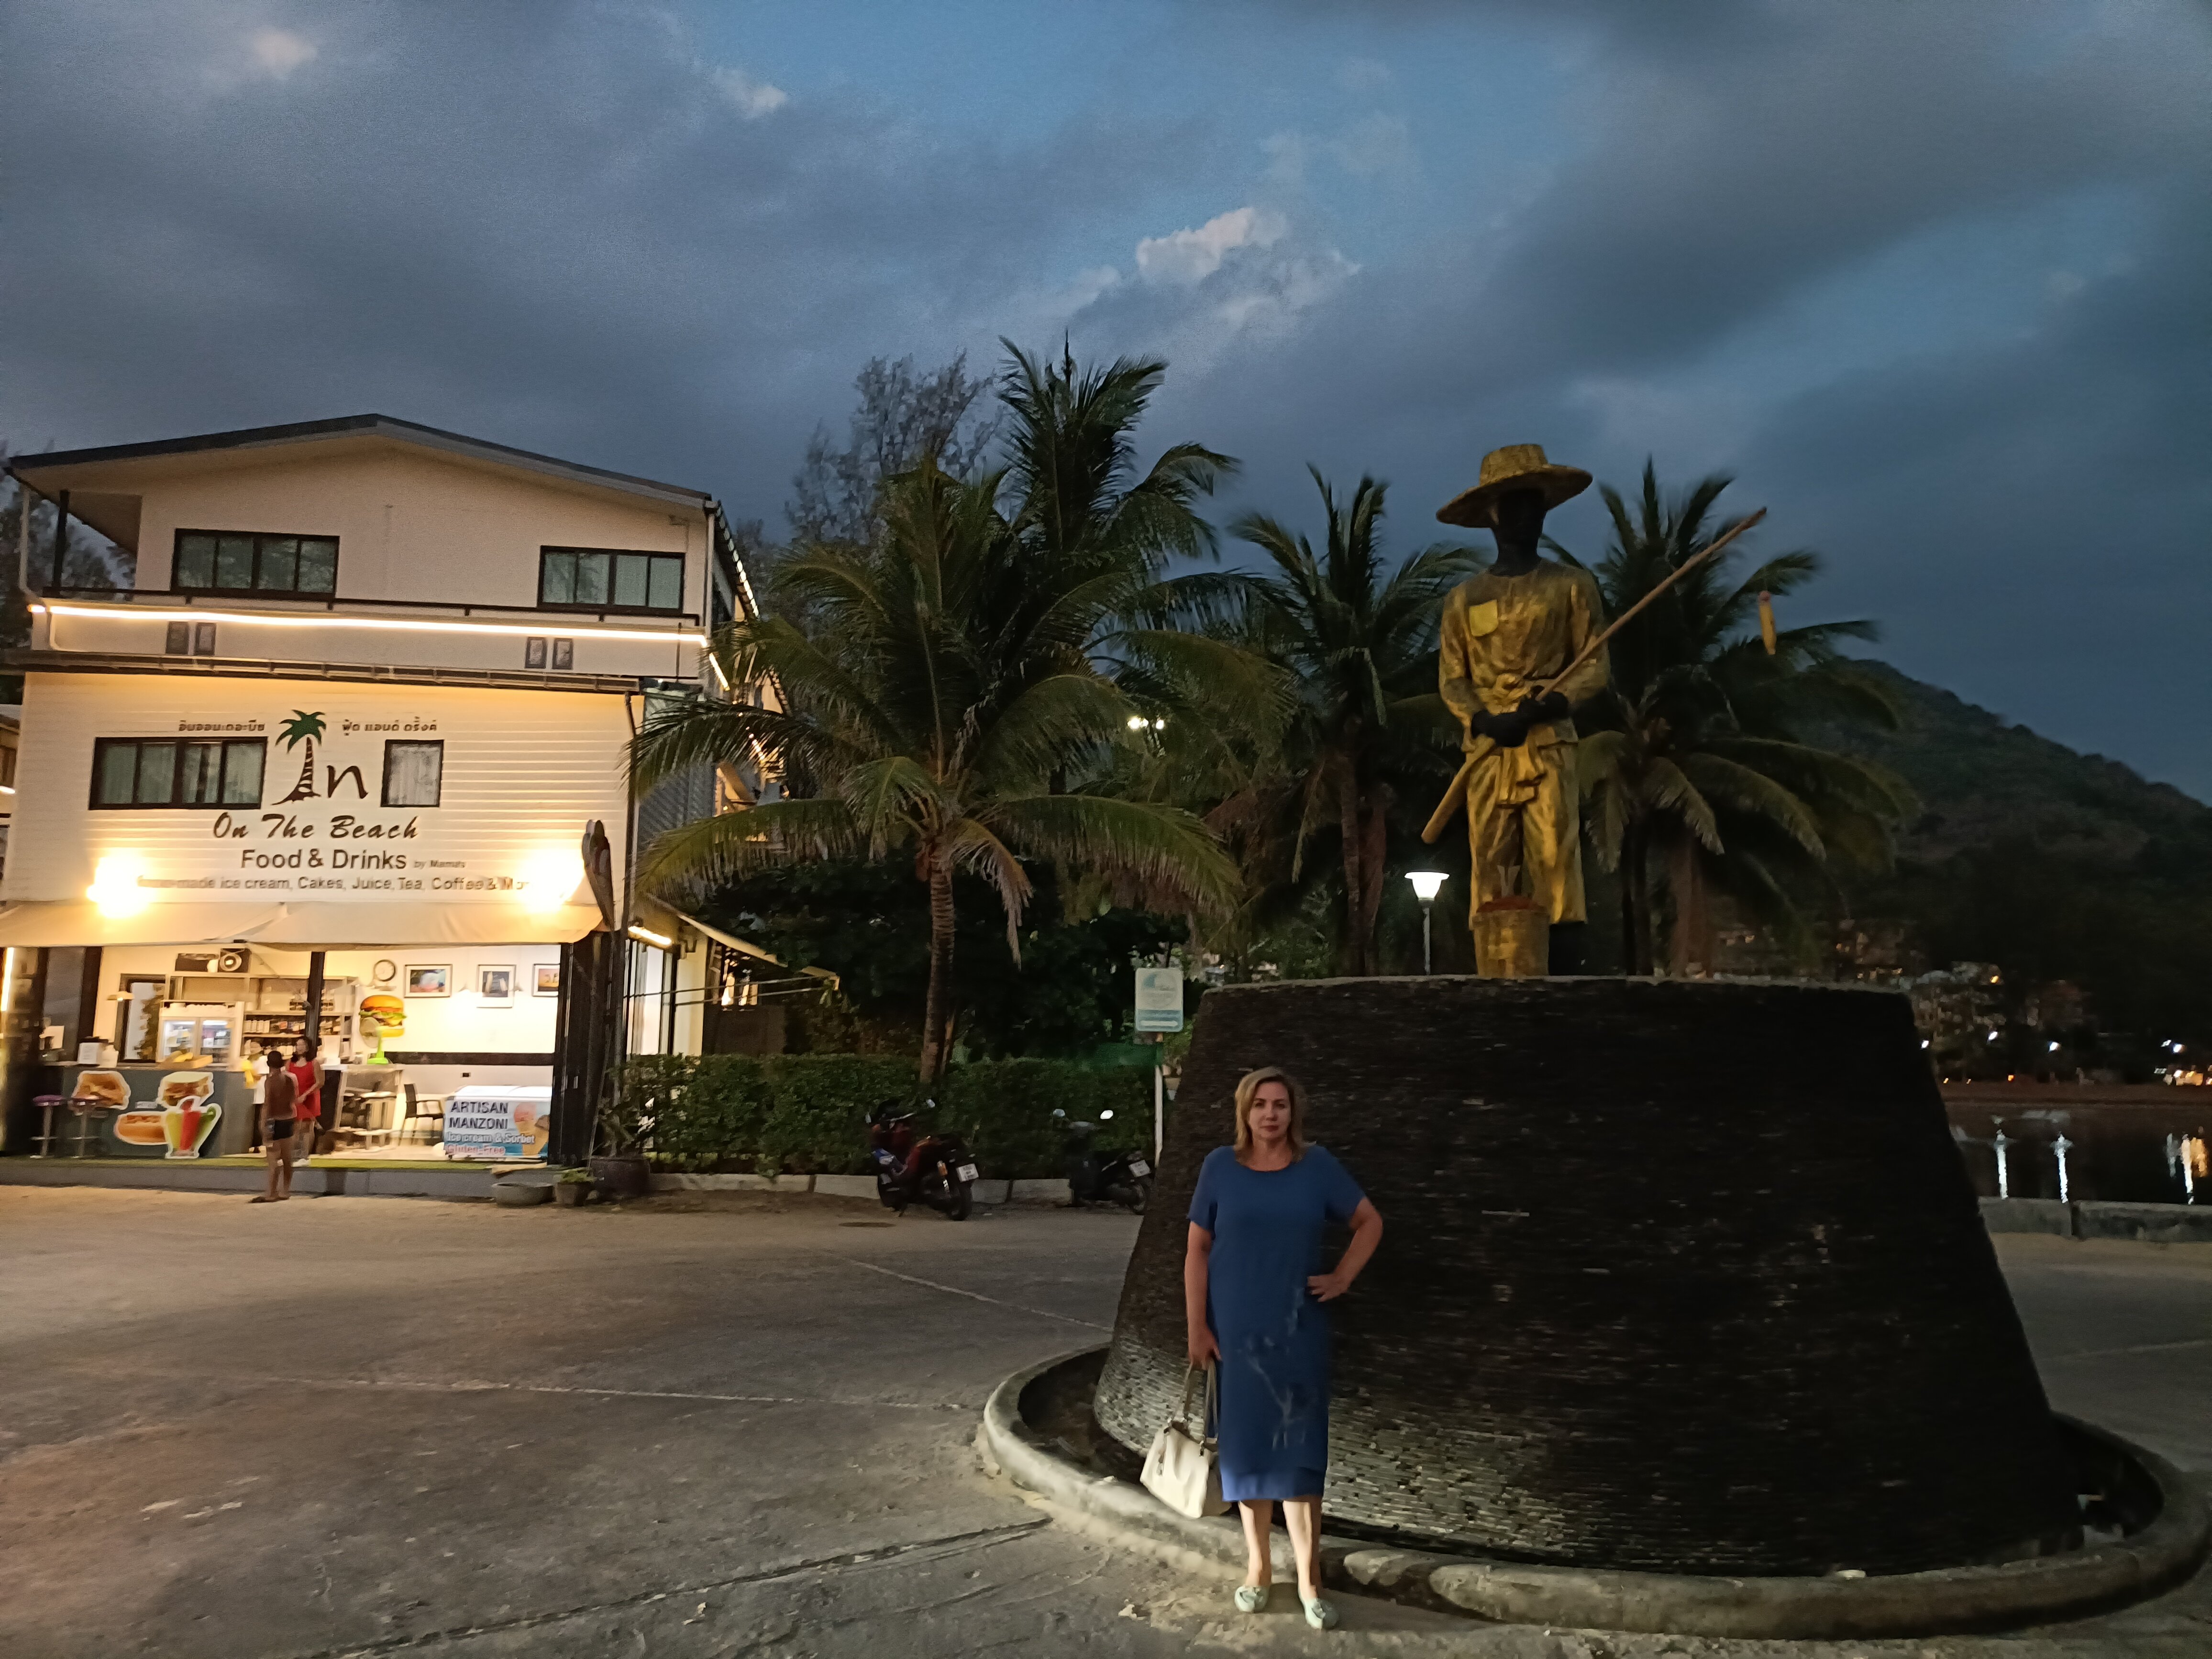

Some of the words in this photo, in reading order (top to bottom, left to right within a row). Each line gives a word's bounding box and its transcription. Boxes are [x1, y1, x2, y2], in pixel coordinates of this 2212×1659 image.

[213, 811, 249, 838] On
[261, 813, 315, 838] The
[330, 815, 419, 839] Beach
[241, 849, 302, 869] Food
[308, 848, 324, 868] &
[332, 849, 407, 869] Drinks
[414, 860, 427, 870] by
[220, 877, 240, 889] ice
[298, 876, 346, 891] Cakes,
[352, 876, 395, 891] Juice,
[432, 877, 483, 890] Coffee
[450, 1101, 509, 1114] ARTISAN
[449, 1117, 508, 1129] MANZONI
[463, 1134, 492, 1143] cream
[495, 1132, 502, 1143] &
[505, 1133, 535, 1144] Sorbet
